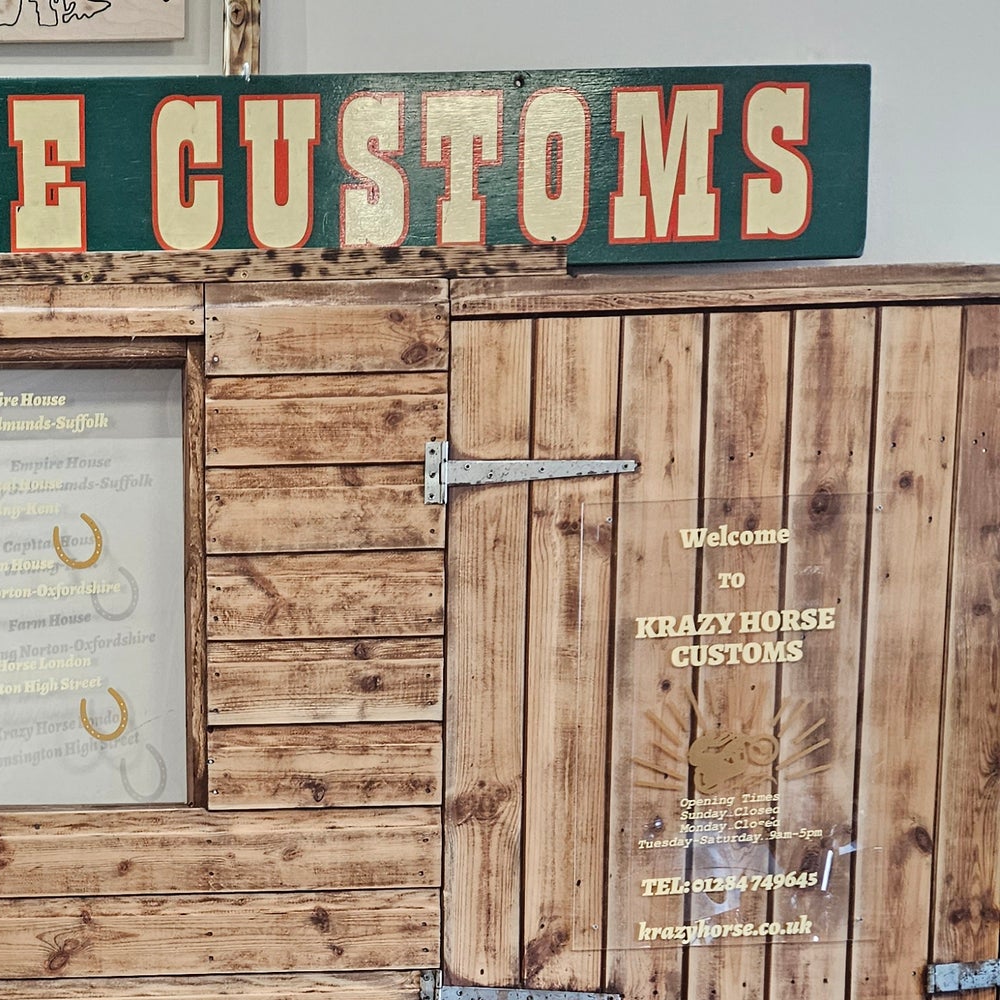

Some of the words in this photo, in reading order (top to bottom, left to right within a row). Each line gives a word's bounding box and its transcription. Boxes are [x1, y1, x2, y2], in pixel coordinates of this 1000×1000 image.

[150, 80, 813, 252] CUSTOMS
[20, 392, 66, 407] House
[679, 524, 791, 549] Welcome
[718, 572, 745, 589] TO
[635, 612, 735, 639] KRAZY
[739, 607, 836, 633] HORSE
[39, 655, 92, 670] London
[671, 640, 804, 668] CUSTOMS
[24, 679, 58, 695] High
[60, 676, 103, 691] Street
[680, 796, 735, 809] Opening
[742, 793, 780, 803] Times
[751, 871, 818, 892] 749645
[638, 915, 813, 943] krazyhorse.co.uk
